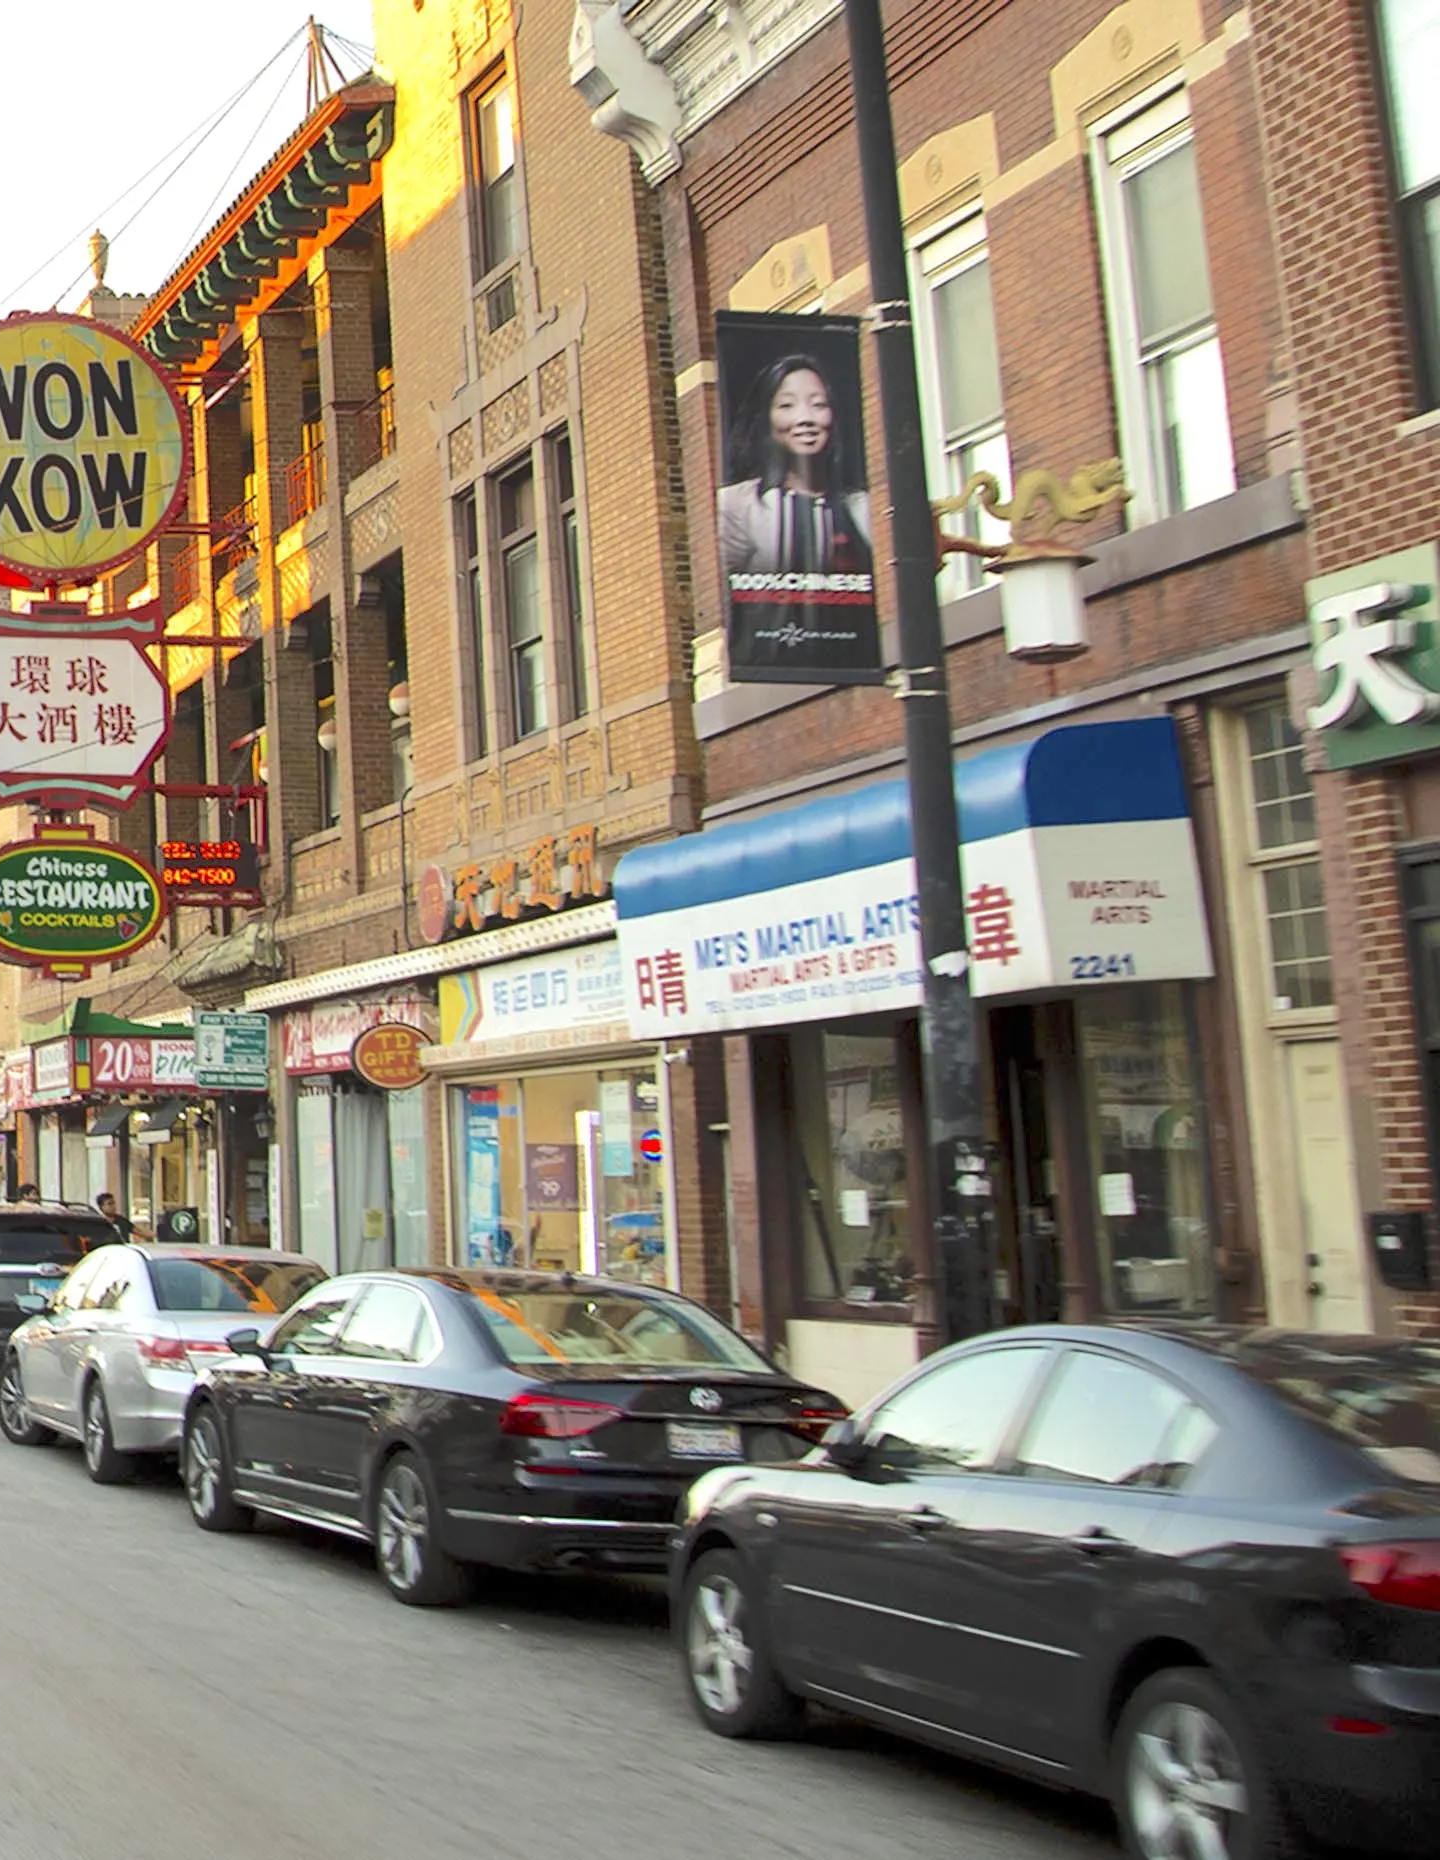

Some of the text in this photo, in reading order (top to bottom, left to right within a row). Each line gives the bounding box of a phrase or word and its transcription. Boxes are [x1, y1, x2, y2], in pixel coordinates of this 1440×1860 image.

[1307, 582, 1428, 730] 天
[10, 654, 109, 697] 環球
[26, 856, 108, 878] Chinese
[163, 868, 235, 885] 842-7500
[1068, 879, 1167, 899] MARTIAL
[20, 911, 116, 928] COCKTAILS
[1091, 905, 1152, 925] ARTS
[694, 931, 749, 970] MEI'S
[756, 911, 855, 961] MARTIAL
[728, 966, 790, 993] MARTIAL
[793, 954, 833, 983] ARTS
[850, 943, 898, 973] GIFTS
[1070, 953, 1136, 980] 2241
[634, 947, 688, 1017] 晴
[375, 1033, 411, 1048] TD
